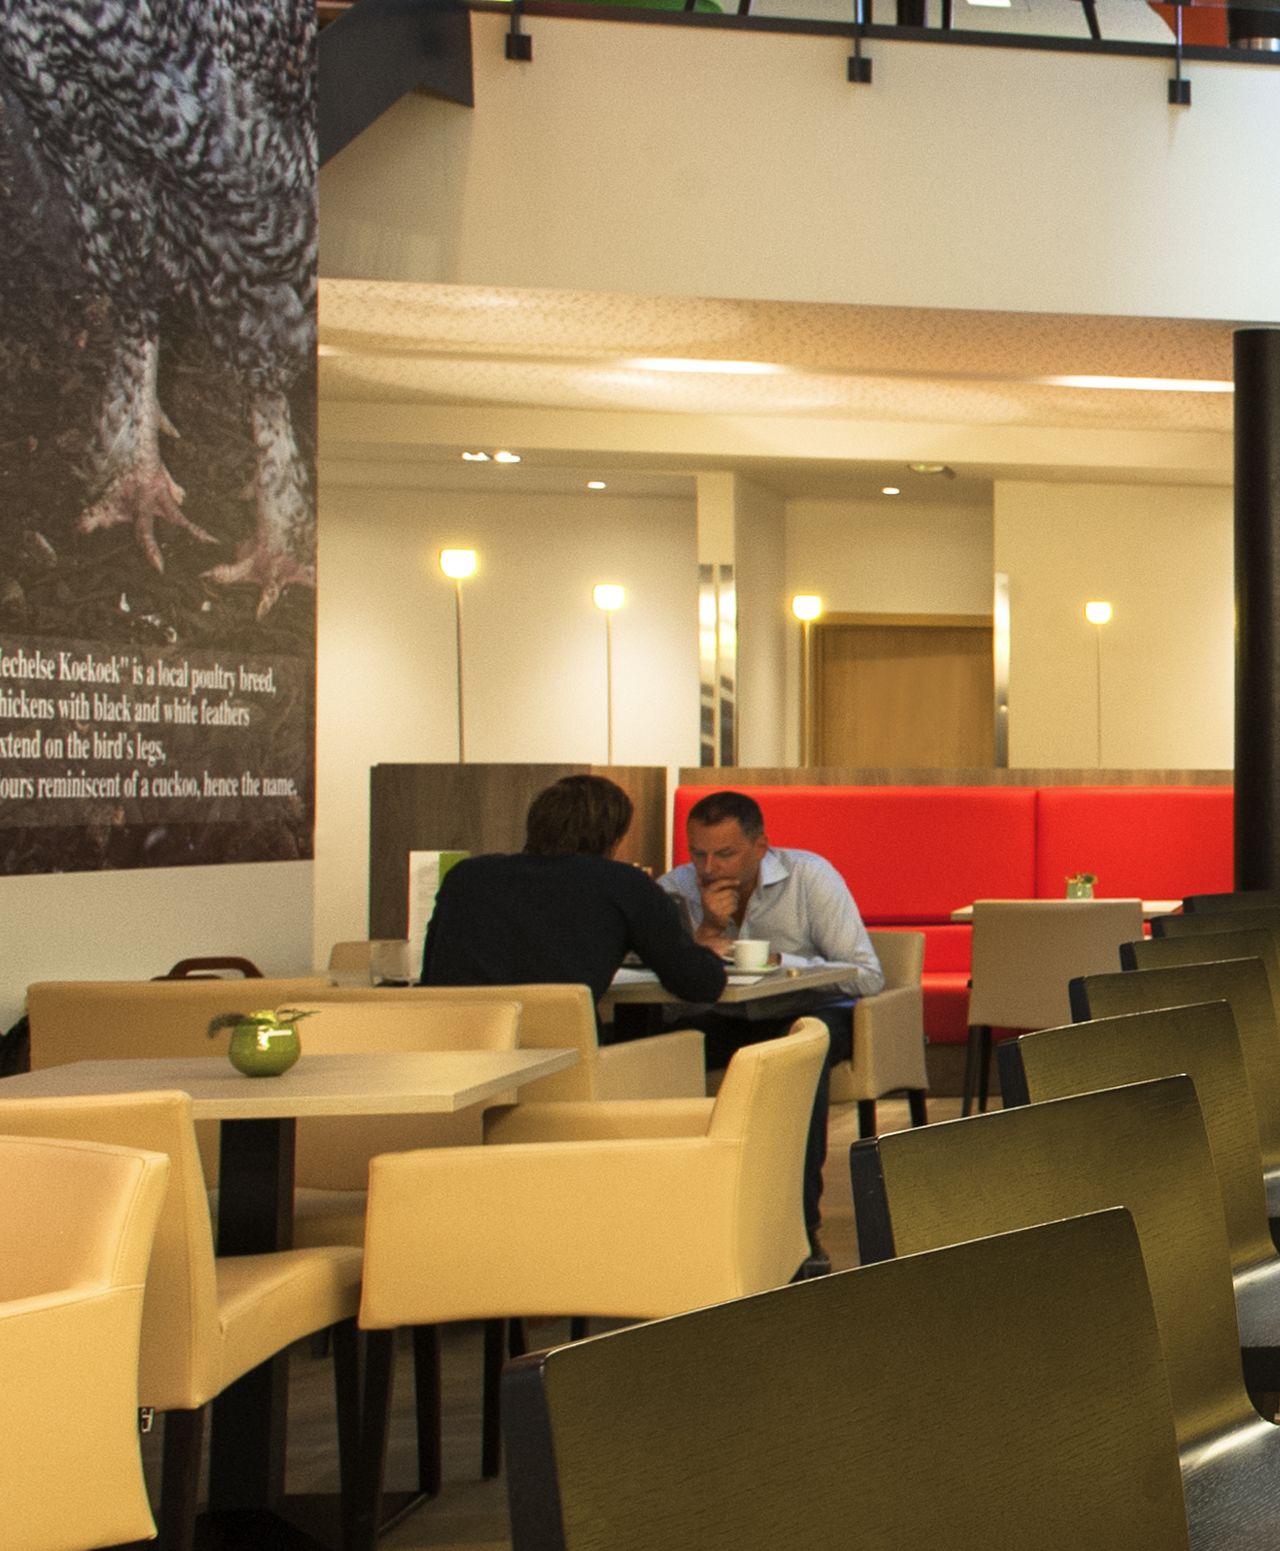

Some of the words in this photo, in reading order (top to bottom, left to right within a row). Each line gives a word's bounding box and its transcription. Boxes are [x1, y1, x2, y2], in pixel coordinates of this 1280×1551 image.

[0, 647, 55, 680] echelse
[59, 652, 129, 684] Koekoek"
[132, 657, 144, 686] is
[146, 665, 155, 686] a
[158, 659, 189, 688] local
[191, 662, 235, 697] poultry
[239, 664, 277, 696] breed,
[58, 692, 90, 720] with
[94, 693, 131, 722] black
[134, 696, 160, 723] and
[163, 697, 198, 725] white
[201, 698, 251, 727] feathers
[45, 738, 63, 759] on
[67, 731, 90, 760] the
[93, 731, 134, 760] bird's
[136, 732, 166, 768] legs,
[37, 769, 121, 799] reminiscent
[124, 769, 139, 798] of
[140, 778, 149, 798] a
[152, 769, 201, 800] cuckoo,
[203, 770, 239, 797] hence
[242, 770, 261, 797] the
[262, 777, 298, 797] name.
